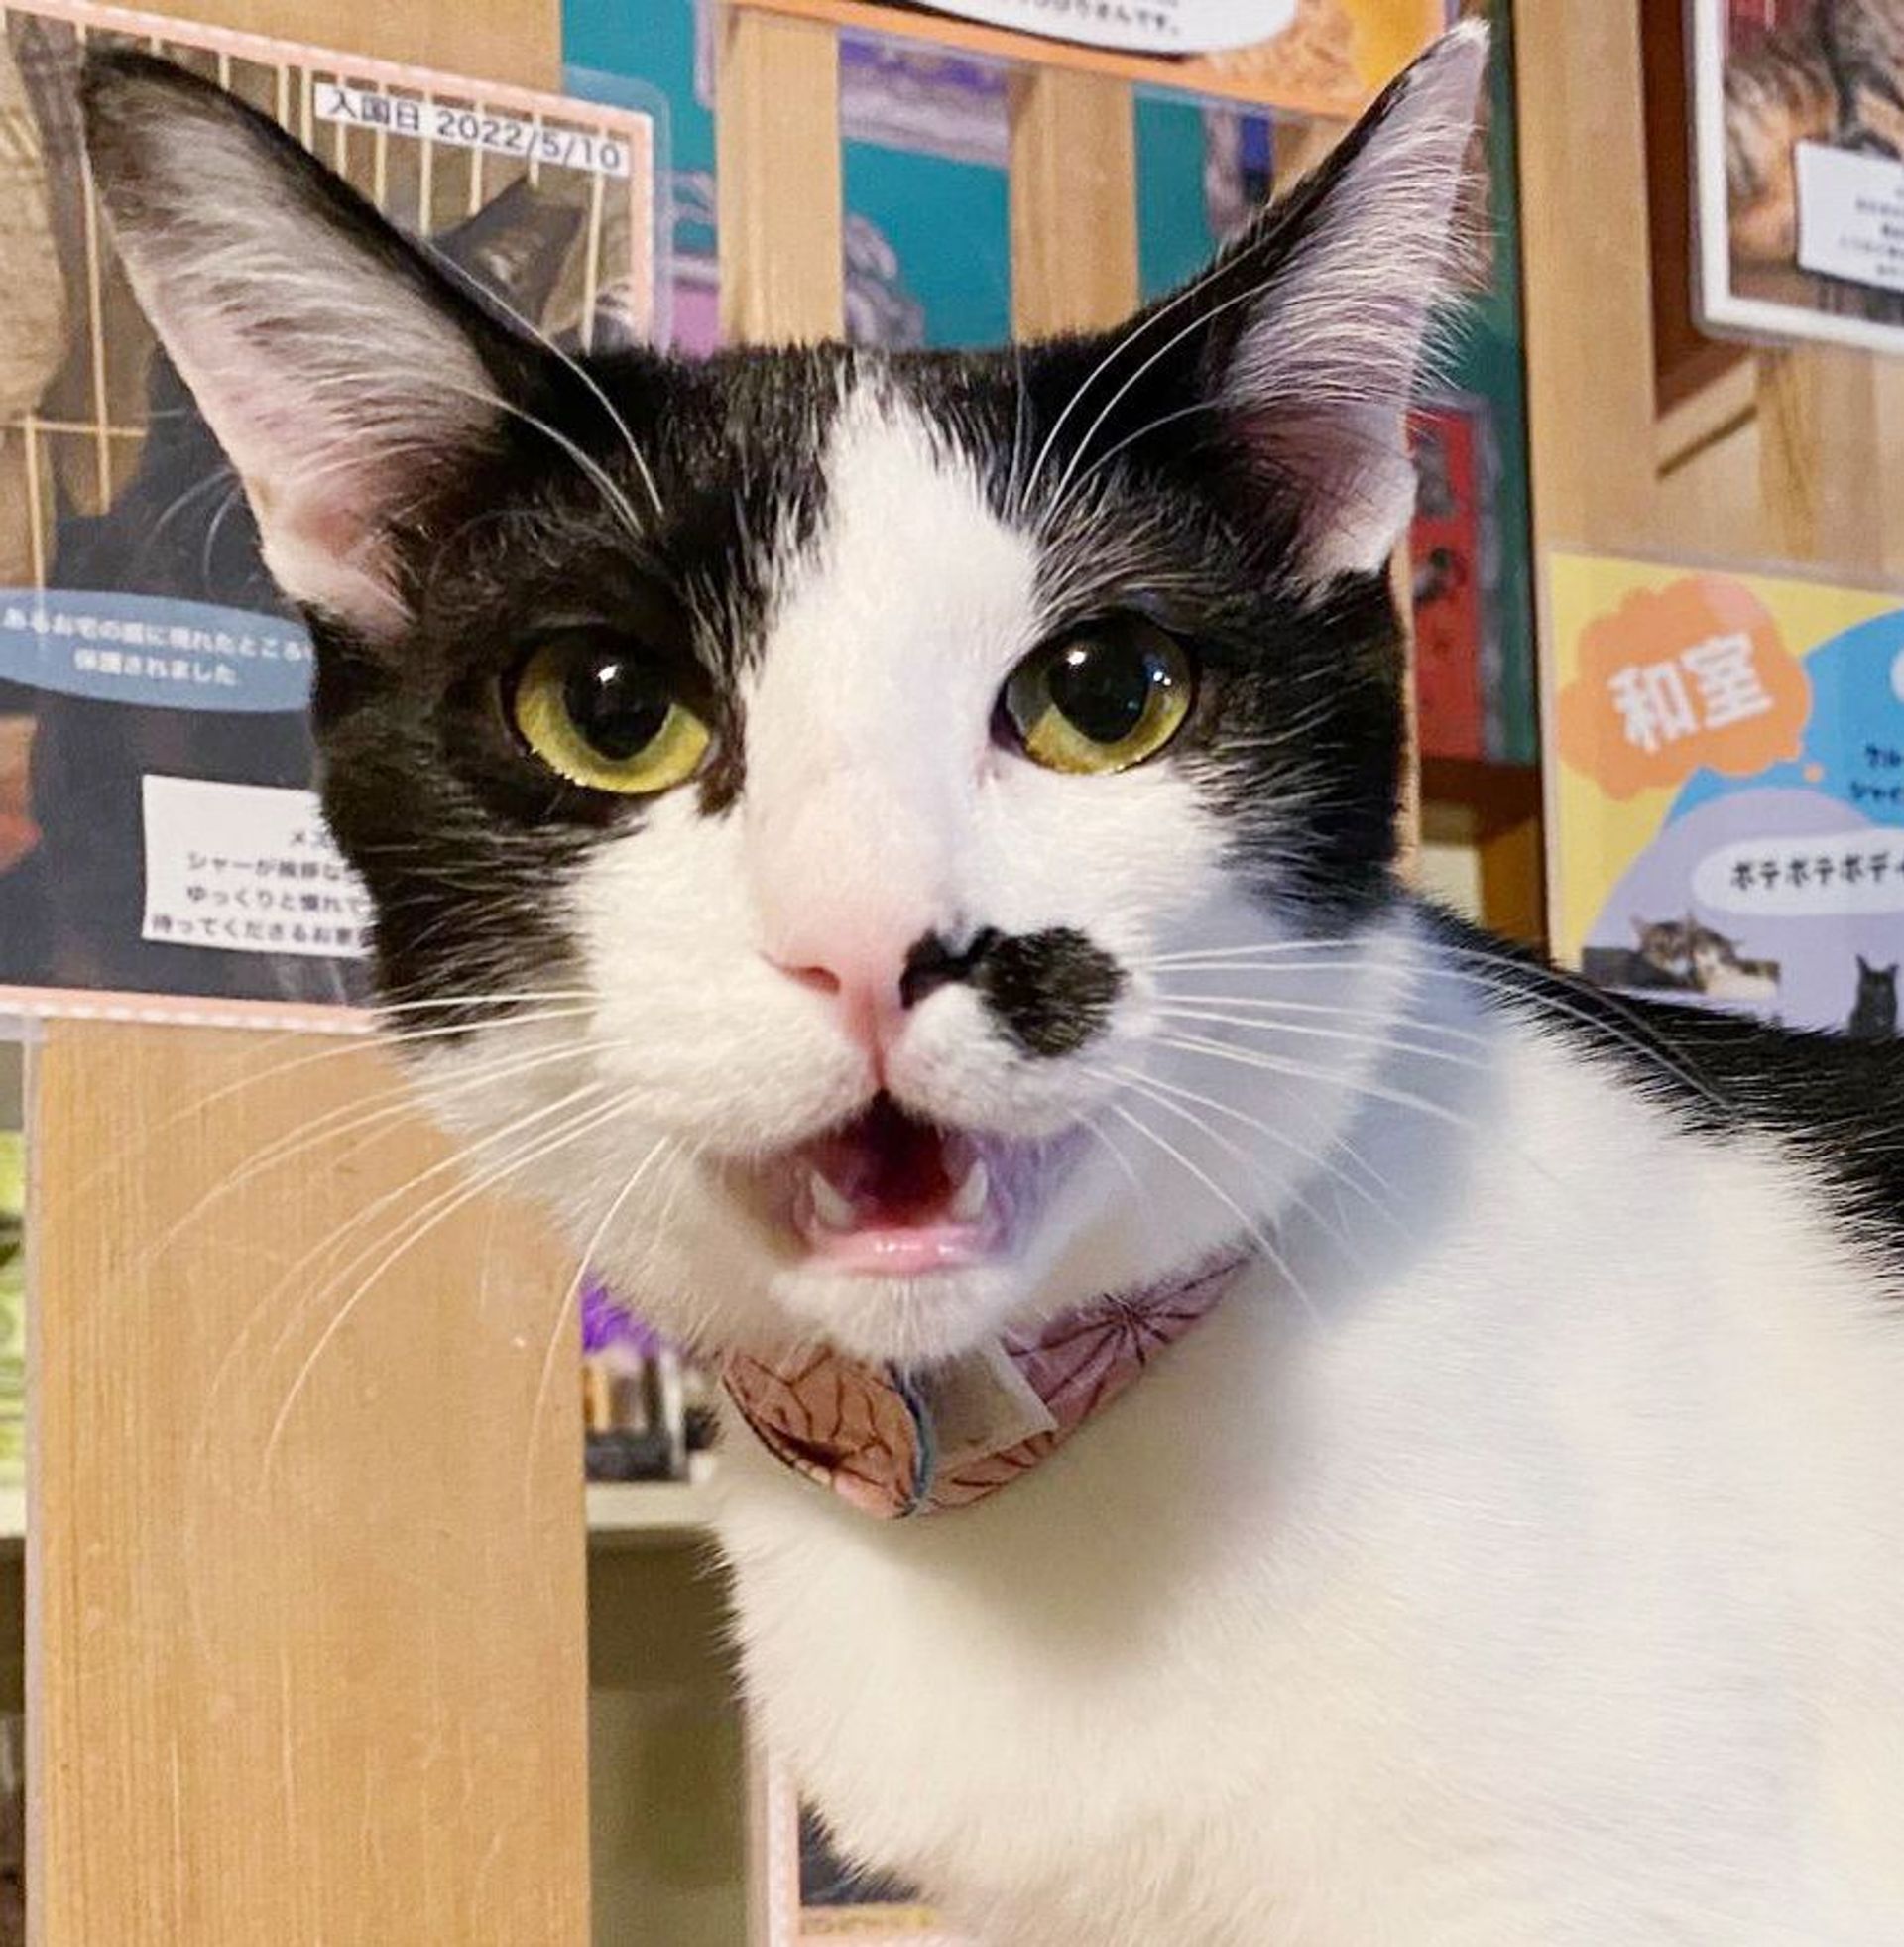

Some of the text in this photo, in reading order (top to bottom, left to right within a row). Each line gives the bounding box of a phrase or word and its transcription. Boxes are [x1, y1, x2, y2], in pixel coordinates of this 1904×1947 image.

[328, 90, 621, 170] 入国日 2022/5/10
[1606, 632, 1775, 756] 和室
